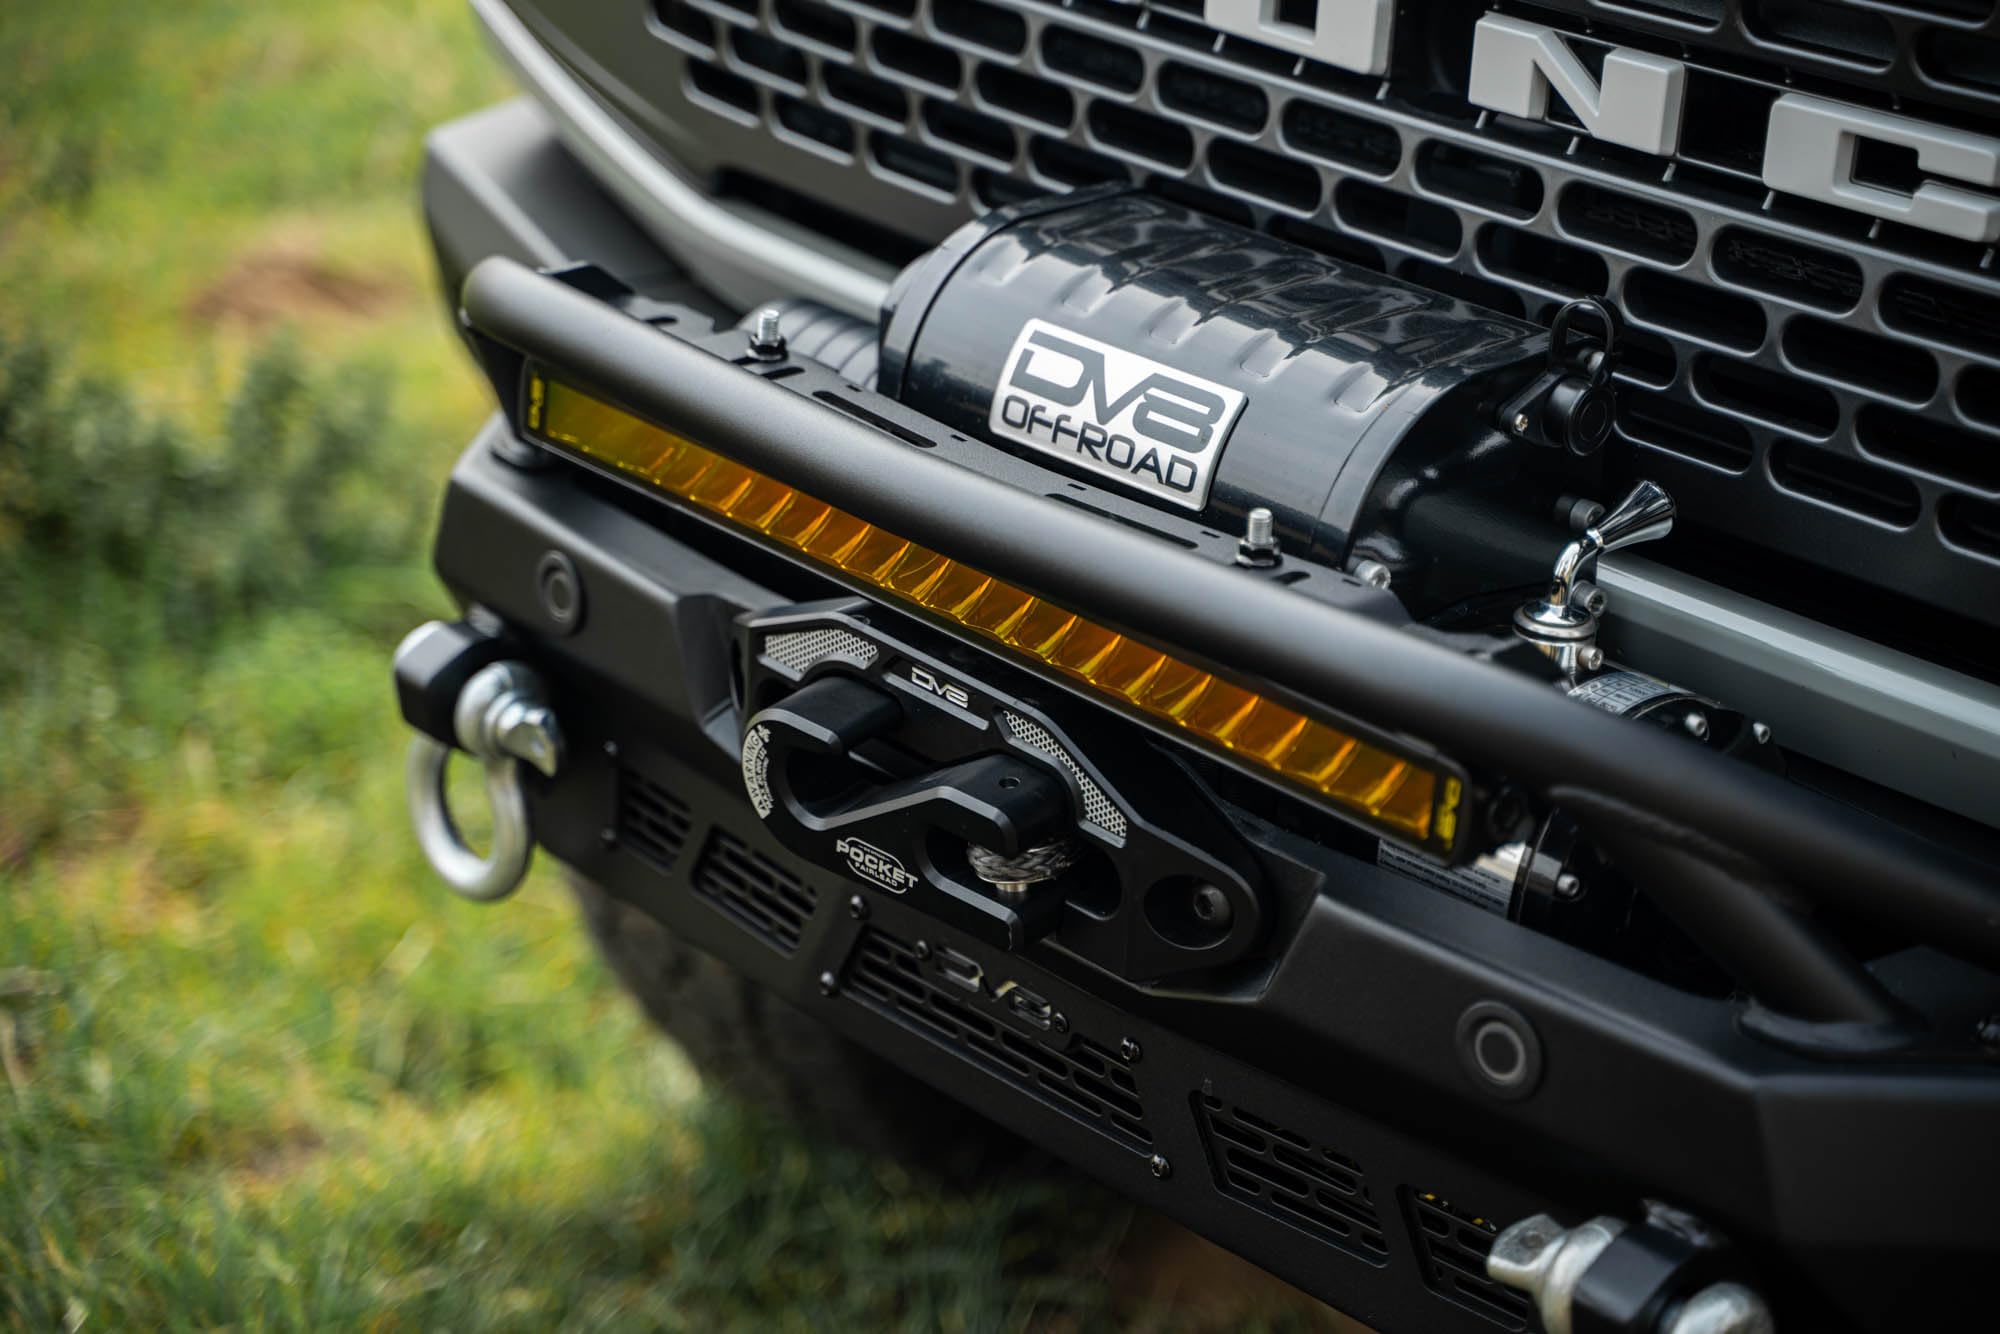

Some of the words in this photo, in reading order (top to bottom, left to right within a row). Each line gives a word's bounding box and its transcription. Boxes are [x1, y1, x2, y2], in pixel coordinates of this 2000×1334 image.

[1009, 330, 1226, 454] DV8
[1001, 395, 1198, 494] OFFROAD
[911, 666, 968, 708] DV8
[745, 735, 761, 798] WARNING
[836, 839, 919, 888] POCKET
[854, 861, 898, 887] FAIRLEAD
